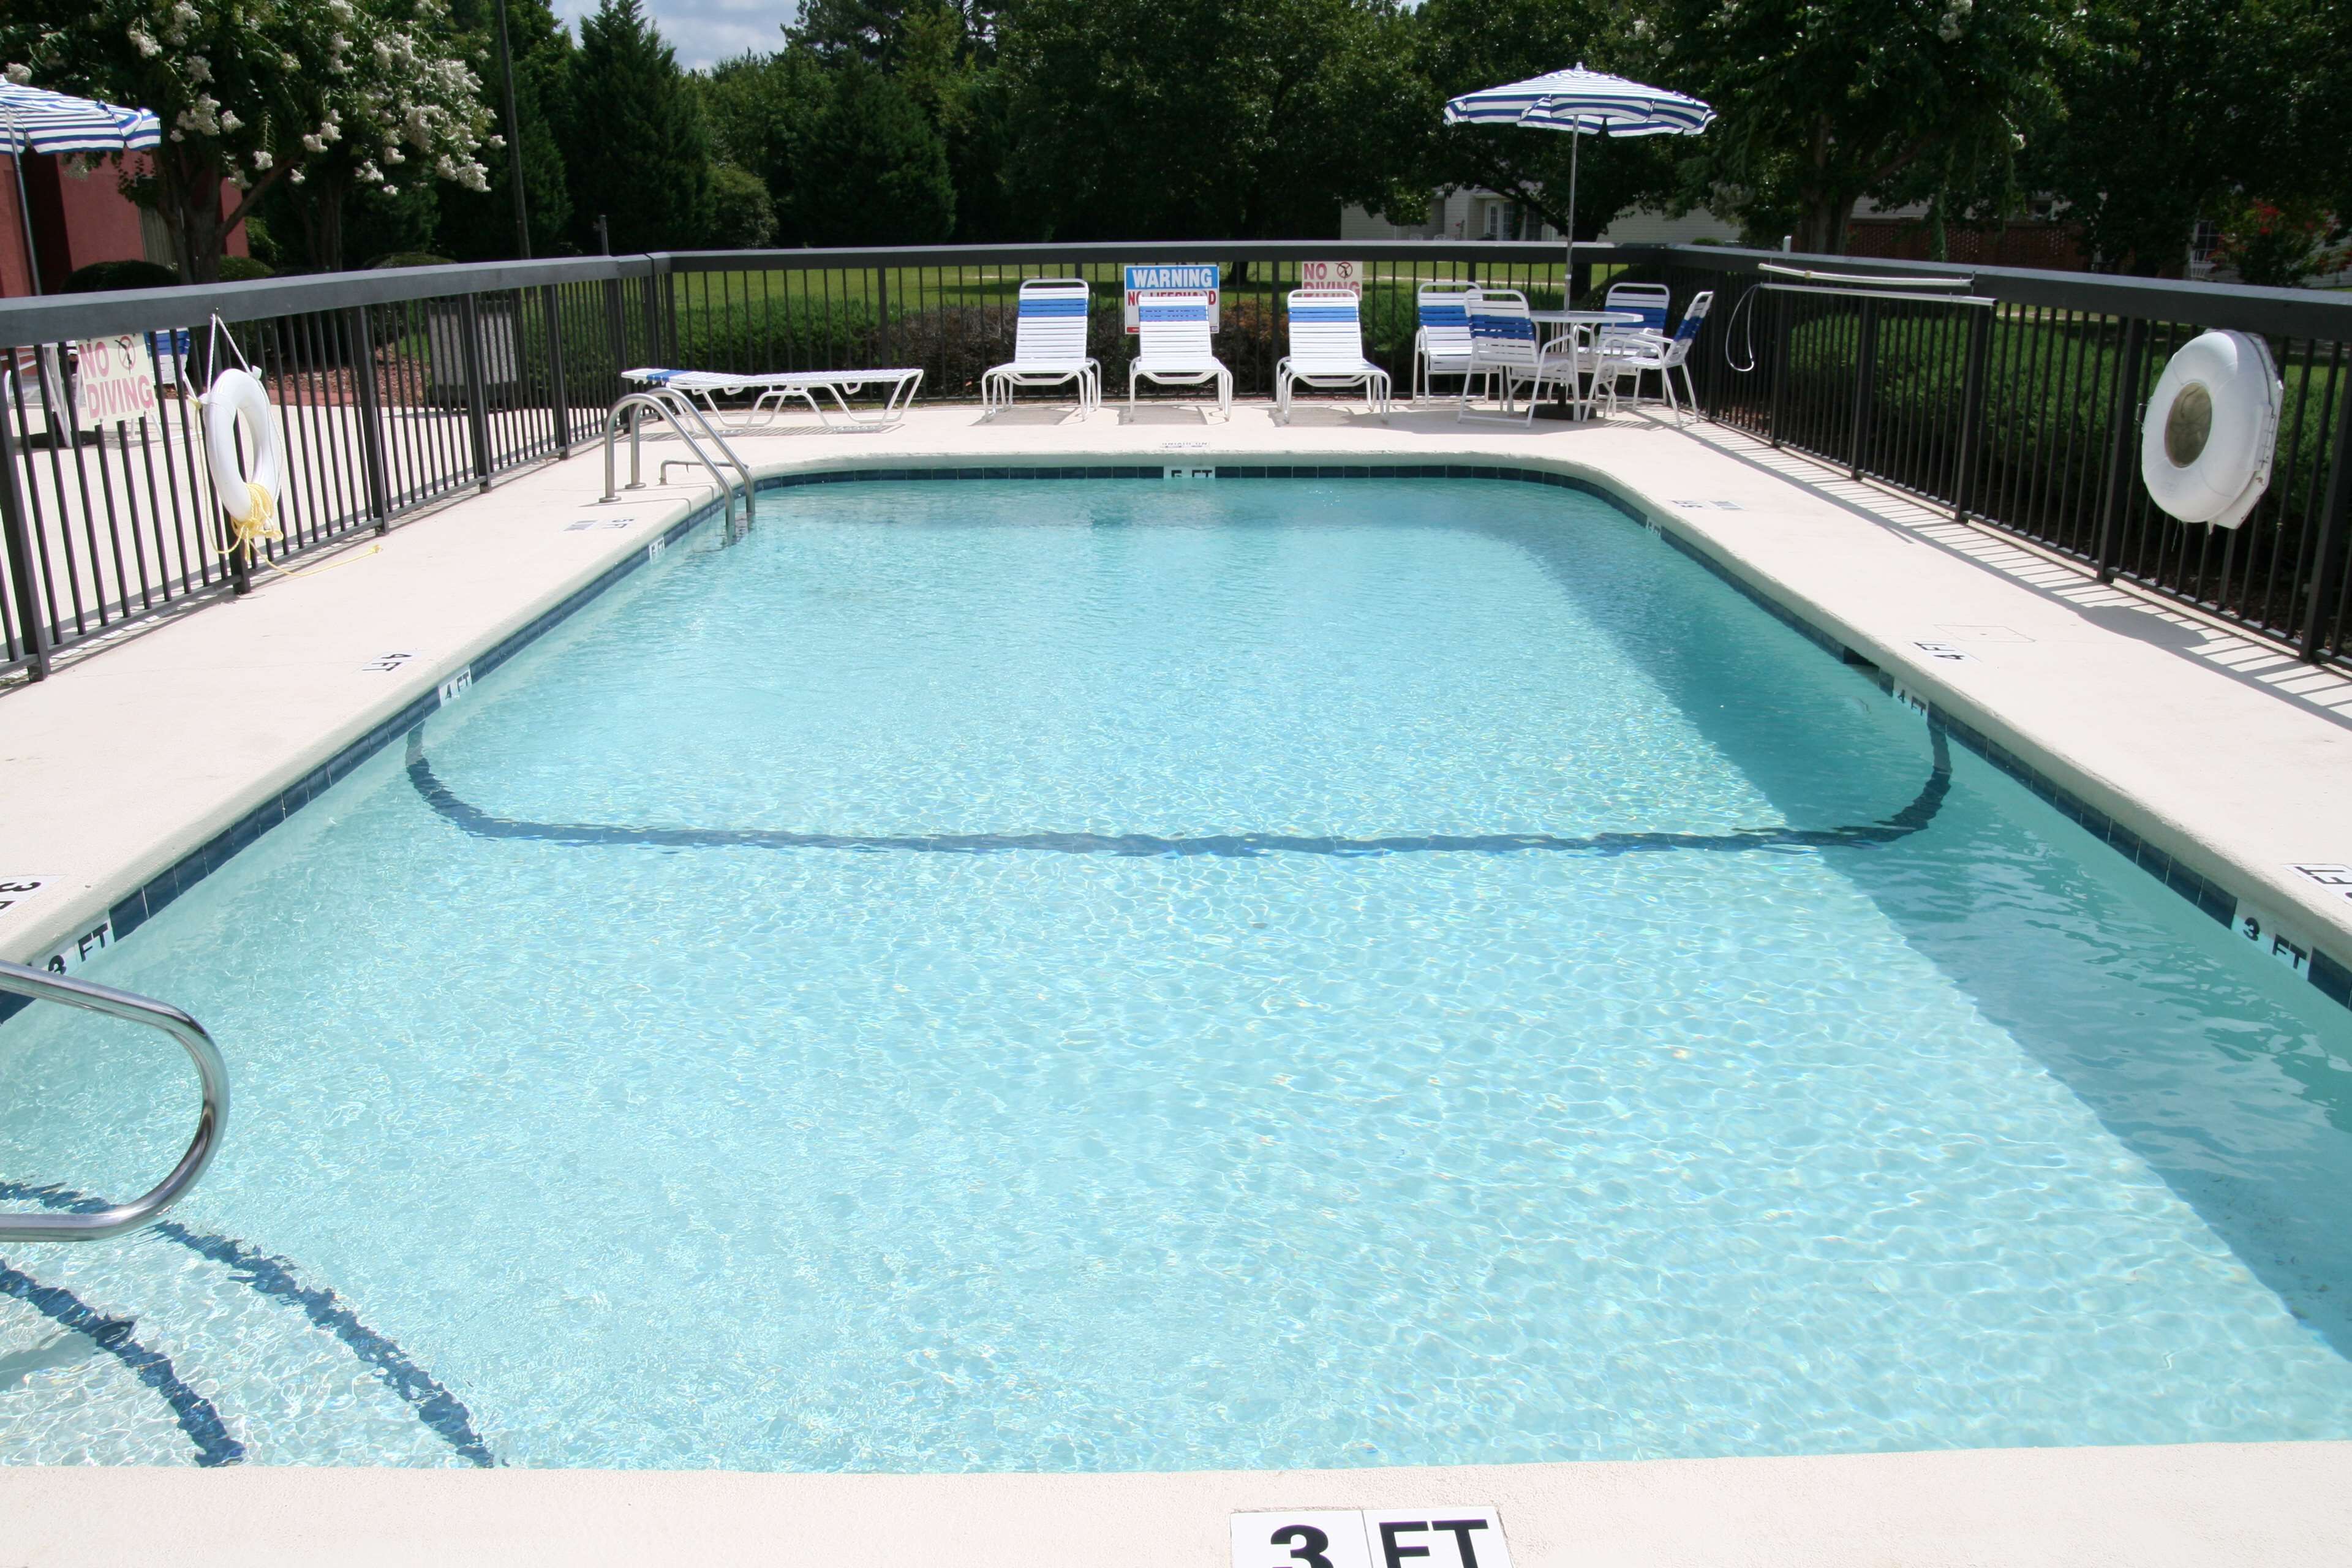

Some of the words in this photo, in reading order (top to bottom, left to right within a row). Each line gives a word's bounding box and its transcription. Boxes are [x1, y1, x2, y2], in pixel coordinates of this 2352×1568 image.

[1132, 268, 1212, 288] WARNING
[1303, 263, 1327, 279] NO
[78, 341, 109, 379] NO
[86, 375, 154, 418] DIVING
[456, 671, 470, 692] FT
[1911, 696, 1926, 716] FT
[78, 922, 108, 962] FT
[2243, 917, 2260, 941] 3
[2272, 933, 2308, 970] FT
[1379, 1519, 1489, 1568] FT
